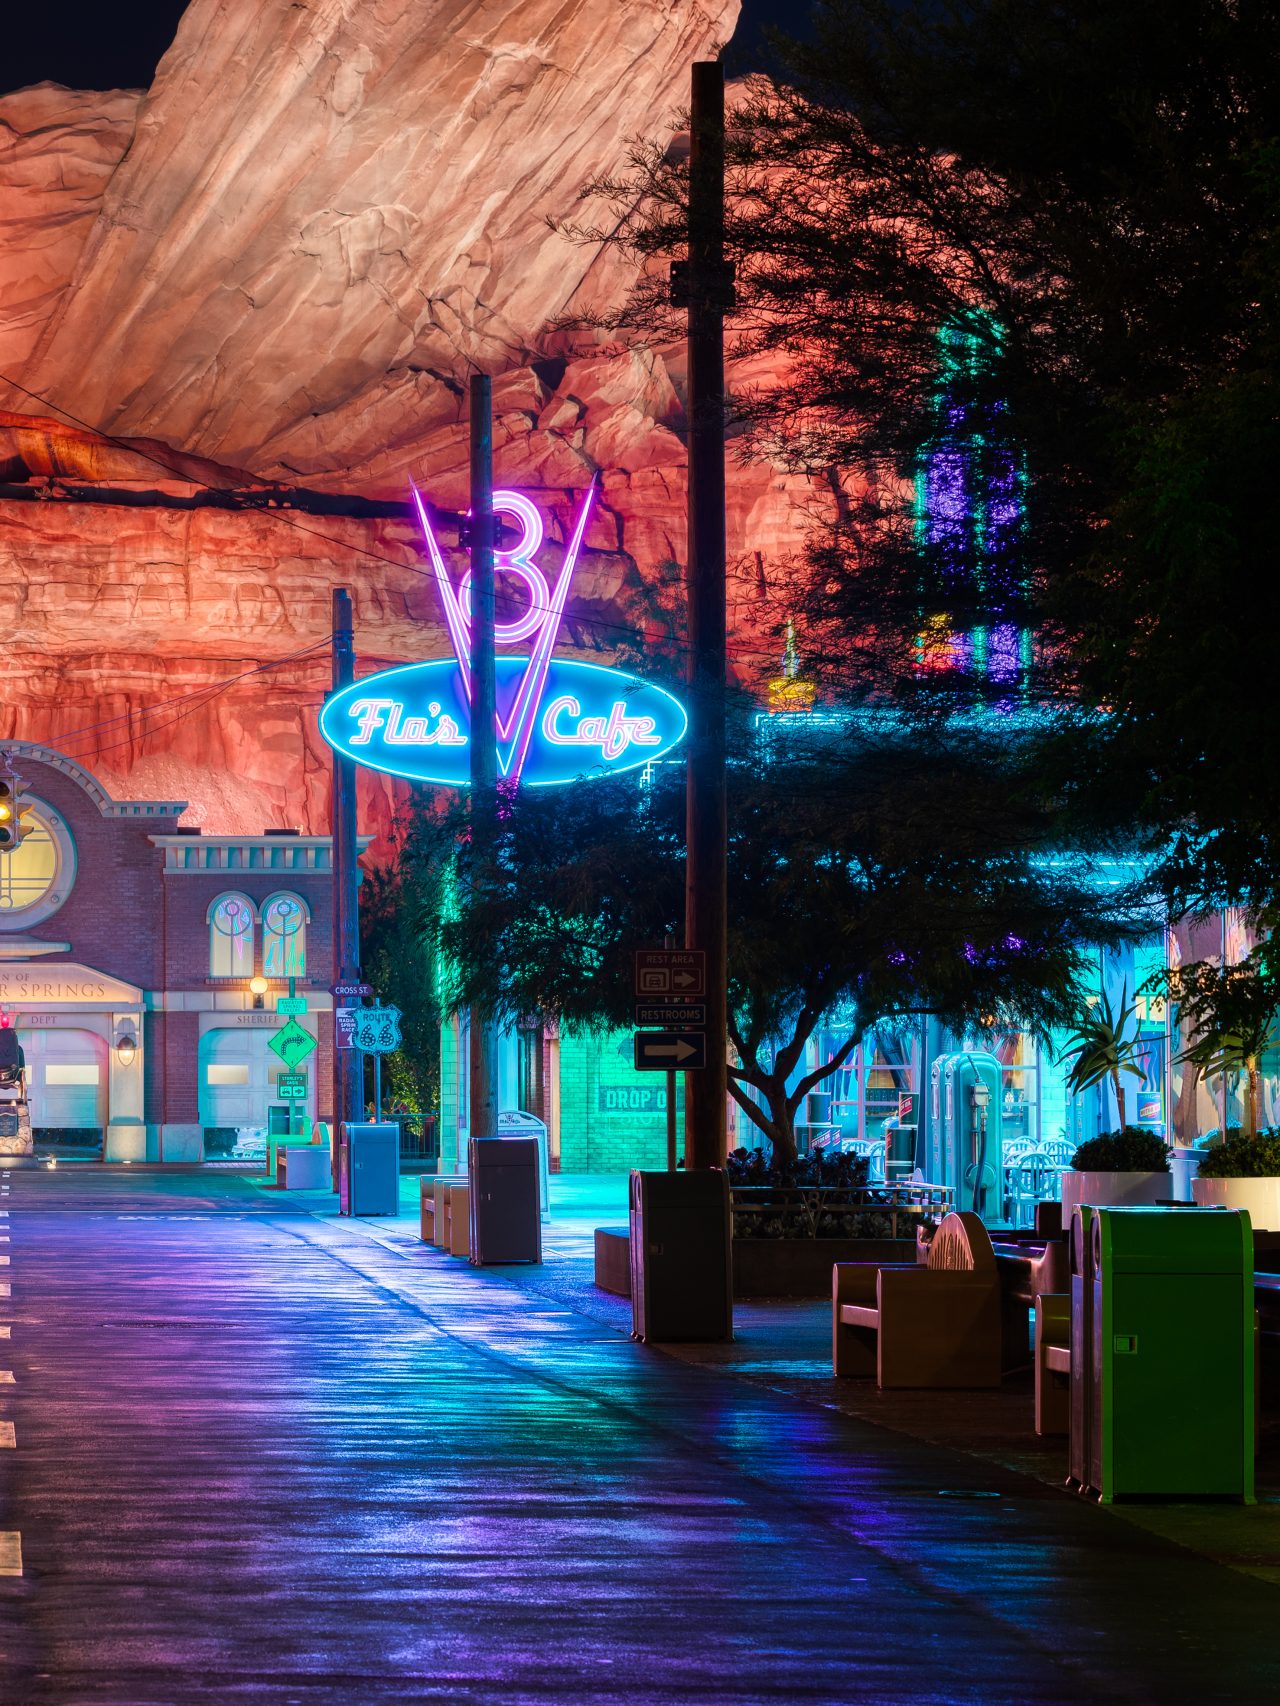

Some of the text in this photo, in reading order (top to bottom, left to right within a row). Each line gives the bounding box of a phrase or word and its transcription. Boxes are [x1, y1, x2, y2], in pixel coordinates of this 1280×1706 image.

[348, 699, 469, 745] Flo's
[542, 695, 662, 760] Cafe
[646, 956, 694, 964] REST AREA
[15, 973, 31, 982] OF
[20, 983, 106, 997] SPRINGS
[31, 1015, 57, 1024] DEPT
[236, 1015, 280, 1024] SHERIFF
[363, 1013, 391, 1023] ROUTE
[640, 1009, 701, 1020] RESTROOMS
[360, 1023, 394, 1046] 66
[606, 1090, 651, 1109] DROP
